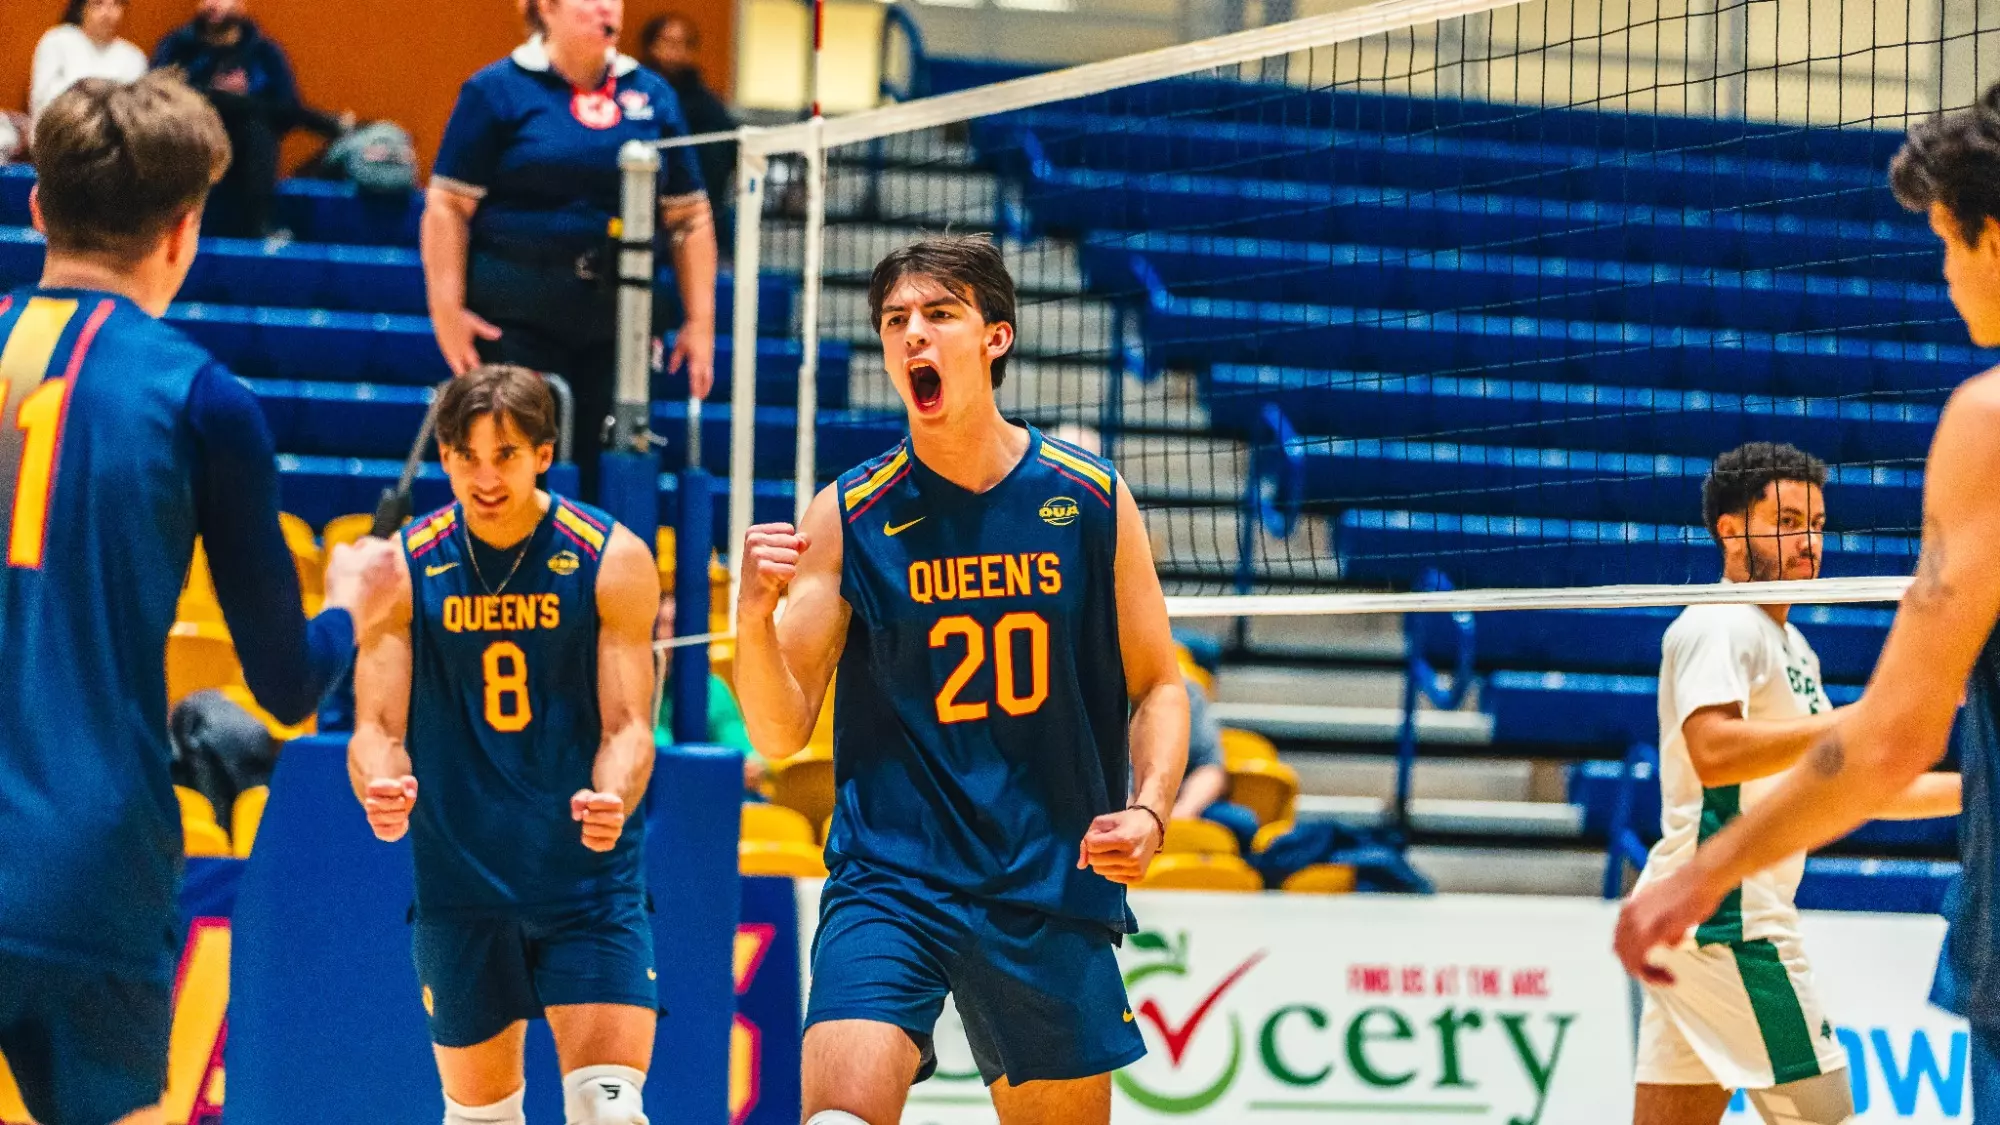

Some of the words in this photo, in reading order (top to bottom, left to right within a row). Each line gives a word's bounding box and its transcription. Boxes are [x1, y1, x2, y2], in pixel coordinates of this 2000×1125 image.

[0, 376, 68, 569] 1
[1039, 505, 1079, 518] OUA
[442, 593, 560, 633] QUEEN'S
[908, 552, 1062, 604] QUEEN'S
[482, 640, 533, 732] 8
[928, 611, 1049, 724] 20
